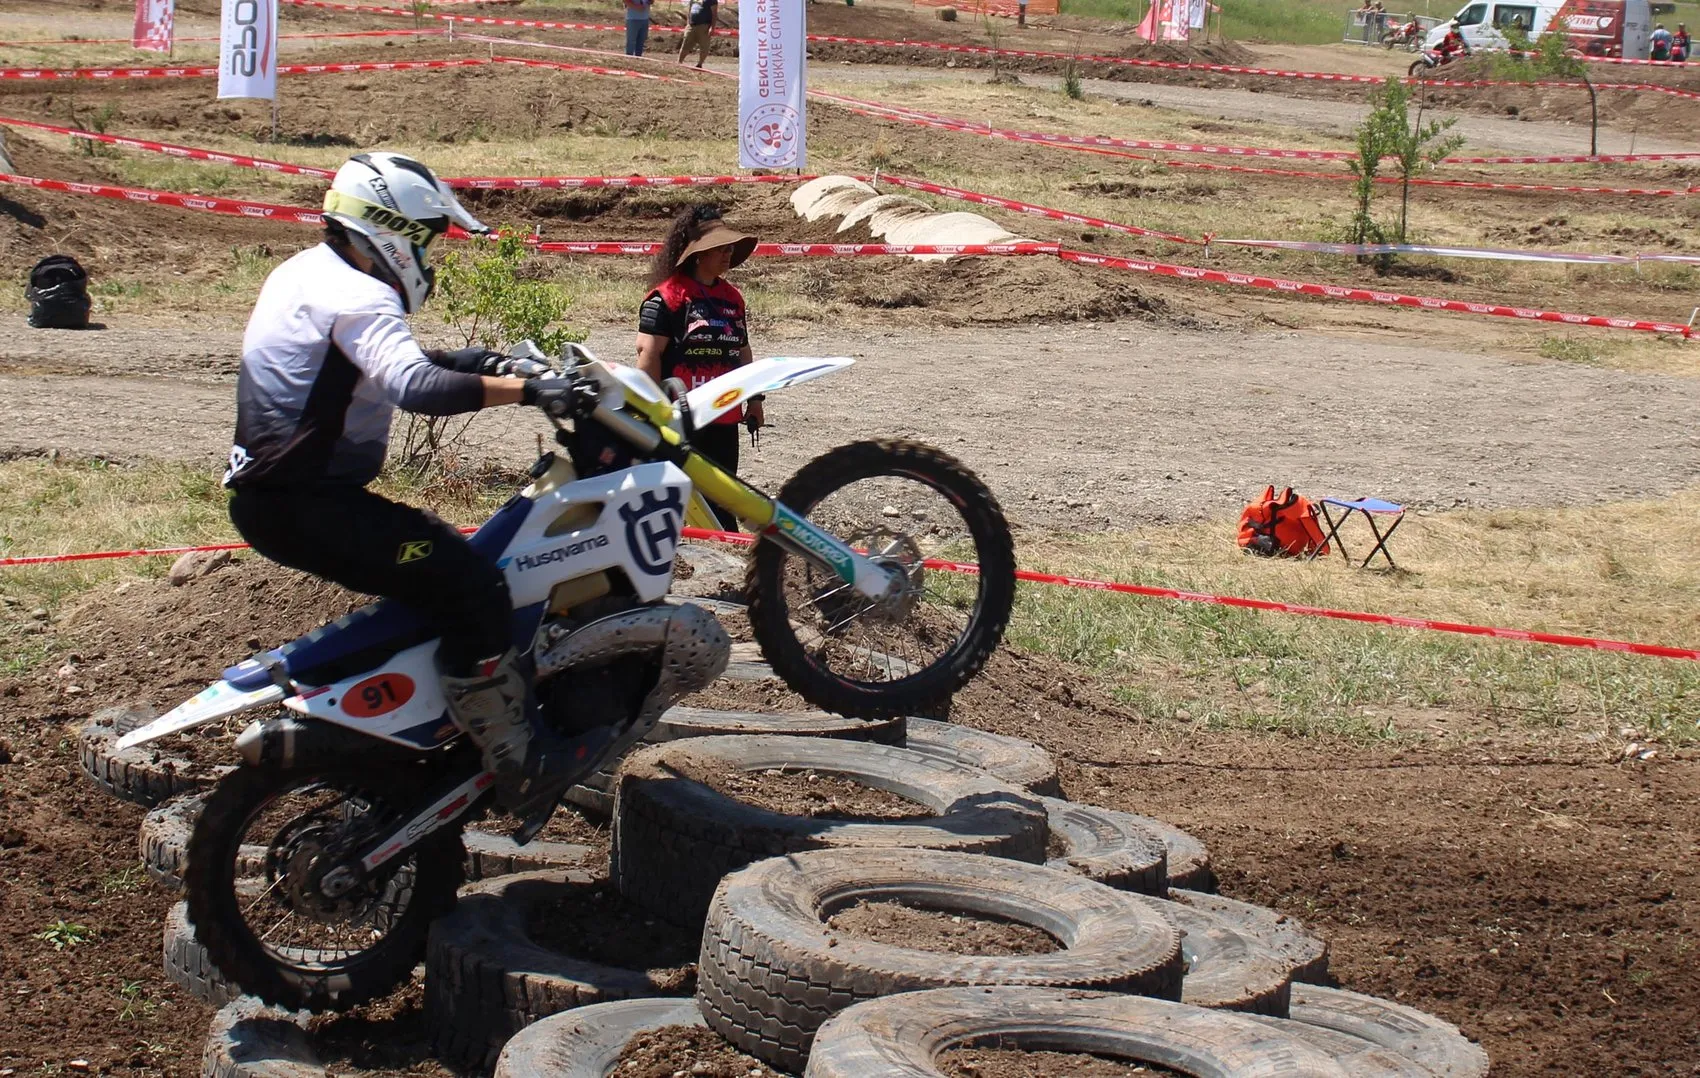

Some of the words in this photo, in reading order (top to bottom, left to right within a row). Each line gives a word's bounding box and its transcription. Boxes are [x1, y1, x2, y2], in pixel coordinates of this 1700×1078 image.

[360, 205, 427, 243] 100%
[515, 534, 611, 572] Husqvarna
[362, 680, 396, 710] 91
